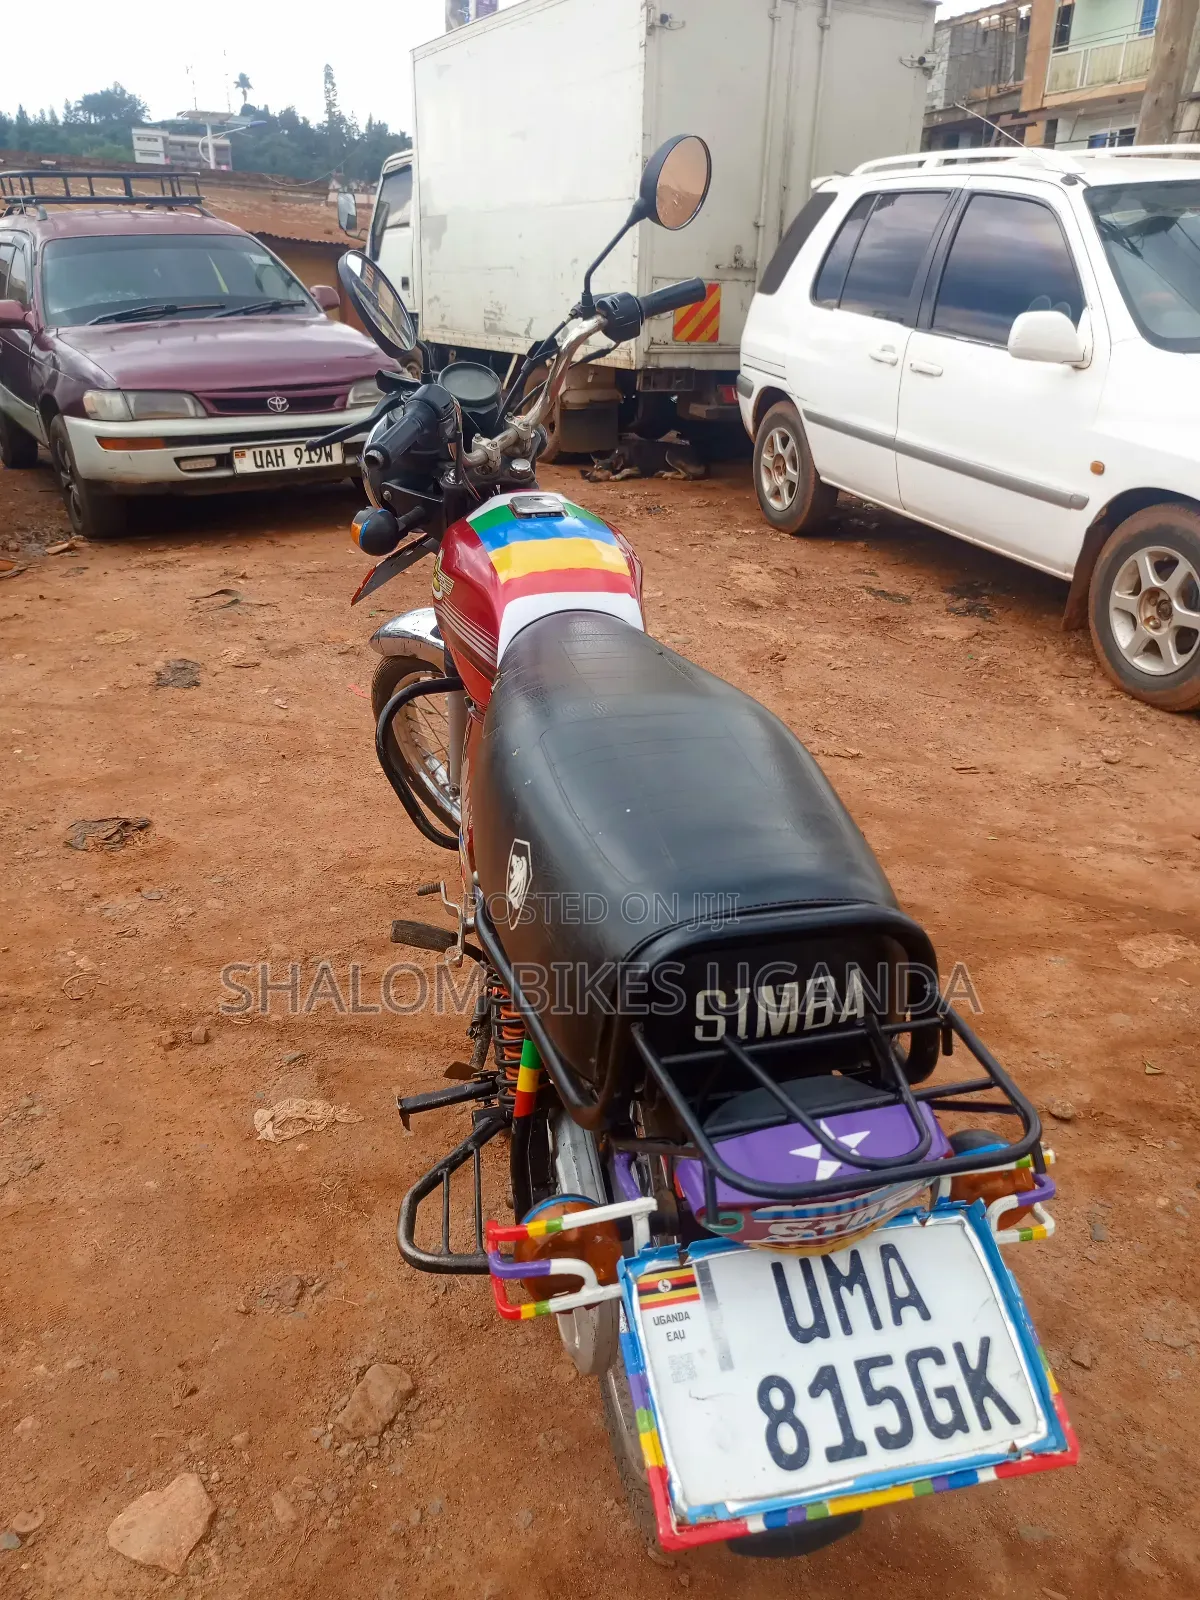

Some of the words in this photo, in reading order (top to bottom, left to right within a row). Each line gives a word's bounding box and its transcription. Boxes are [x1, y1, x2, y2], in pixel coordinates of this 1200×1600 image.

[253, 448, 286, 469] UAH
[294, 444, 333, 465] 919W
[694, 967, 865, 1042] SIMBA
[652, 1311, 691, 1326] UGANDA
[771, 1243, 931, 1344] UMA
[666, 1329, 686, 1342] EAU
[757, 1336, 1021, 1471] 815GK
